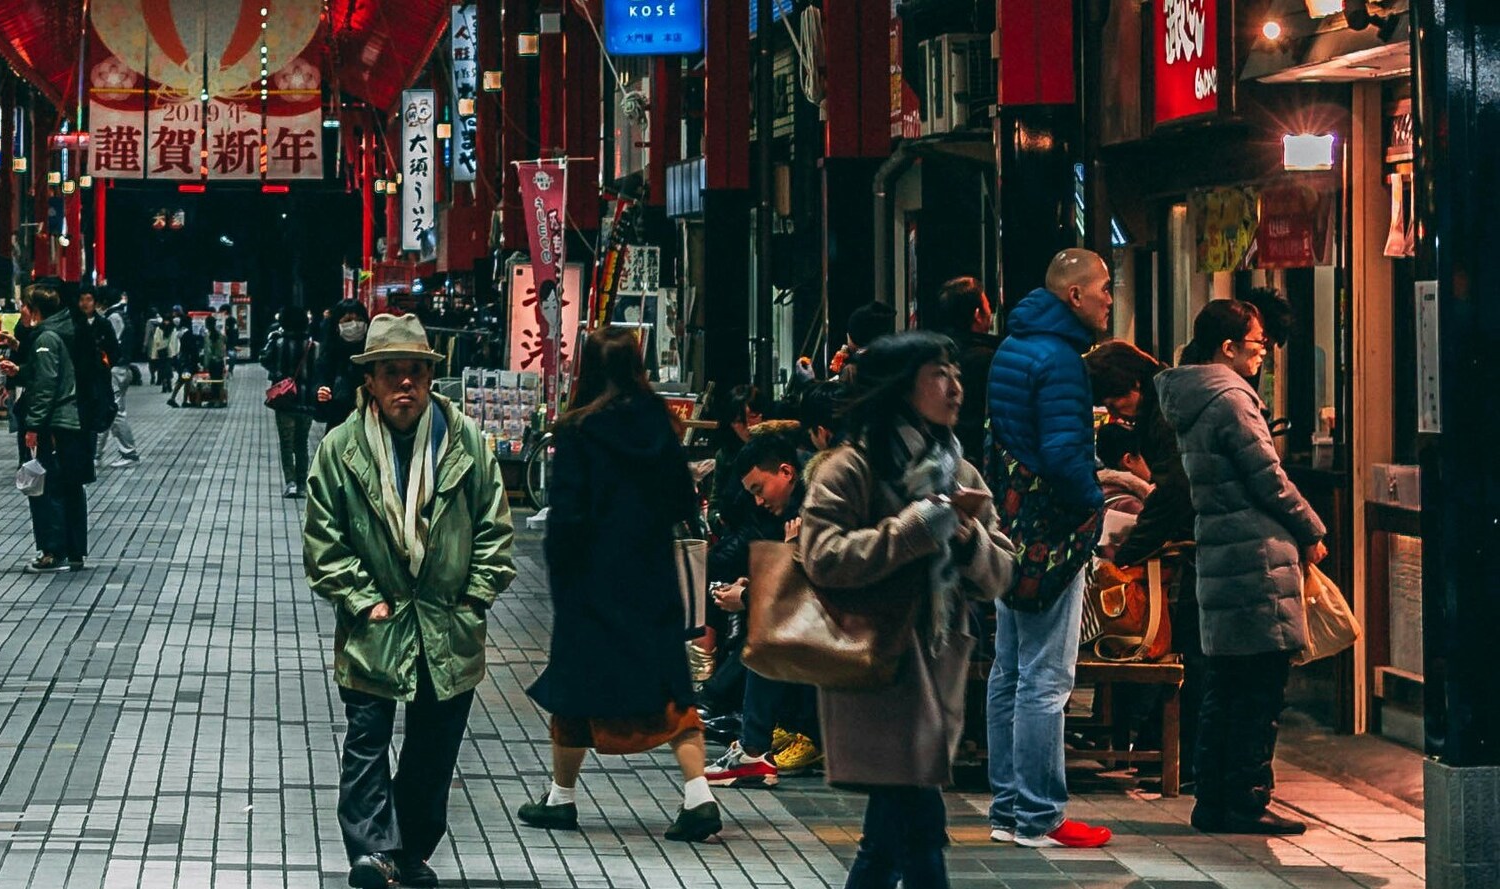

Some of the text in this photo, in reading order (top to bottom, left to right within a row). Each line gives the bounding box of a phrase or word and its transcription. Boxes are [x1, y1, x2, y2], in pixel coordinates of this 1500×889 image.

[629, 3, 675, 17] KOSÉ
[94, 125, 318, 175] 謹賀新年
[409, 134, 428, 241] 大須ういろ
